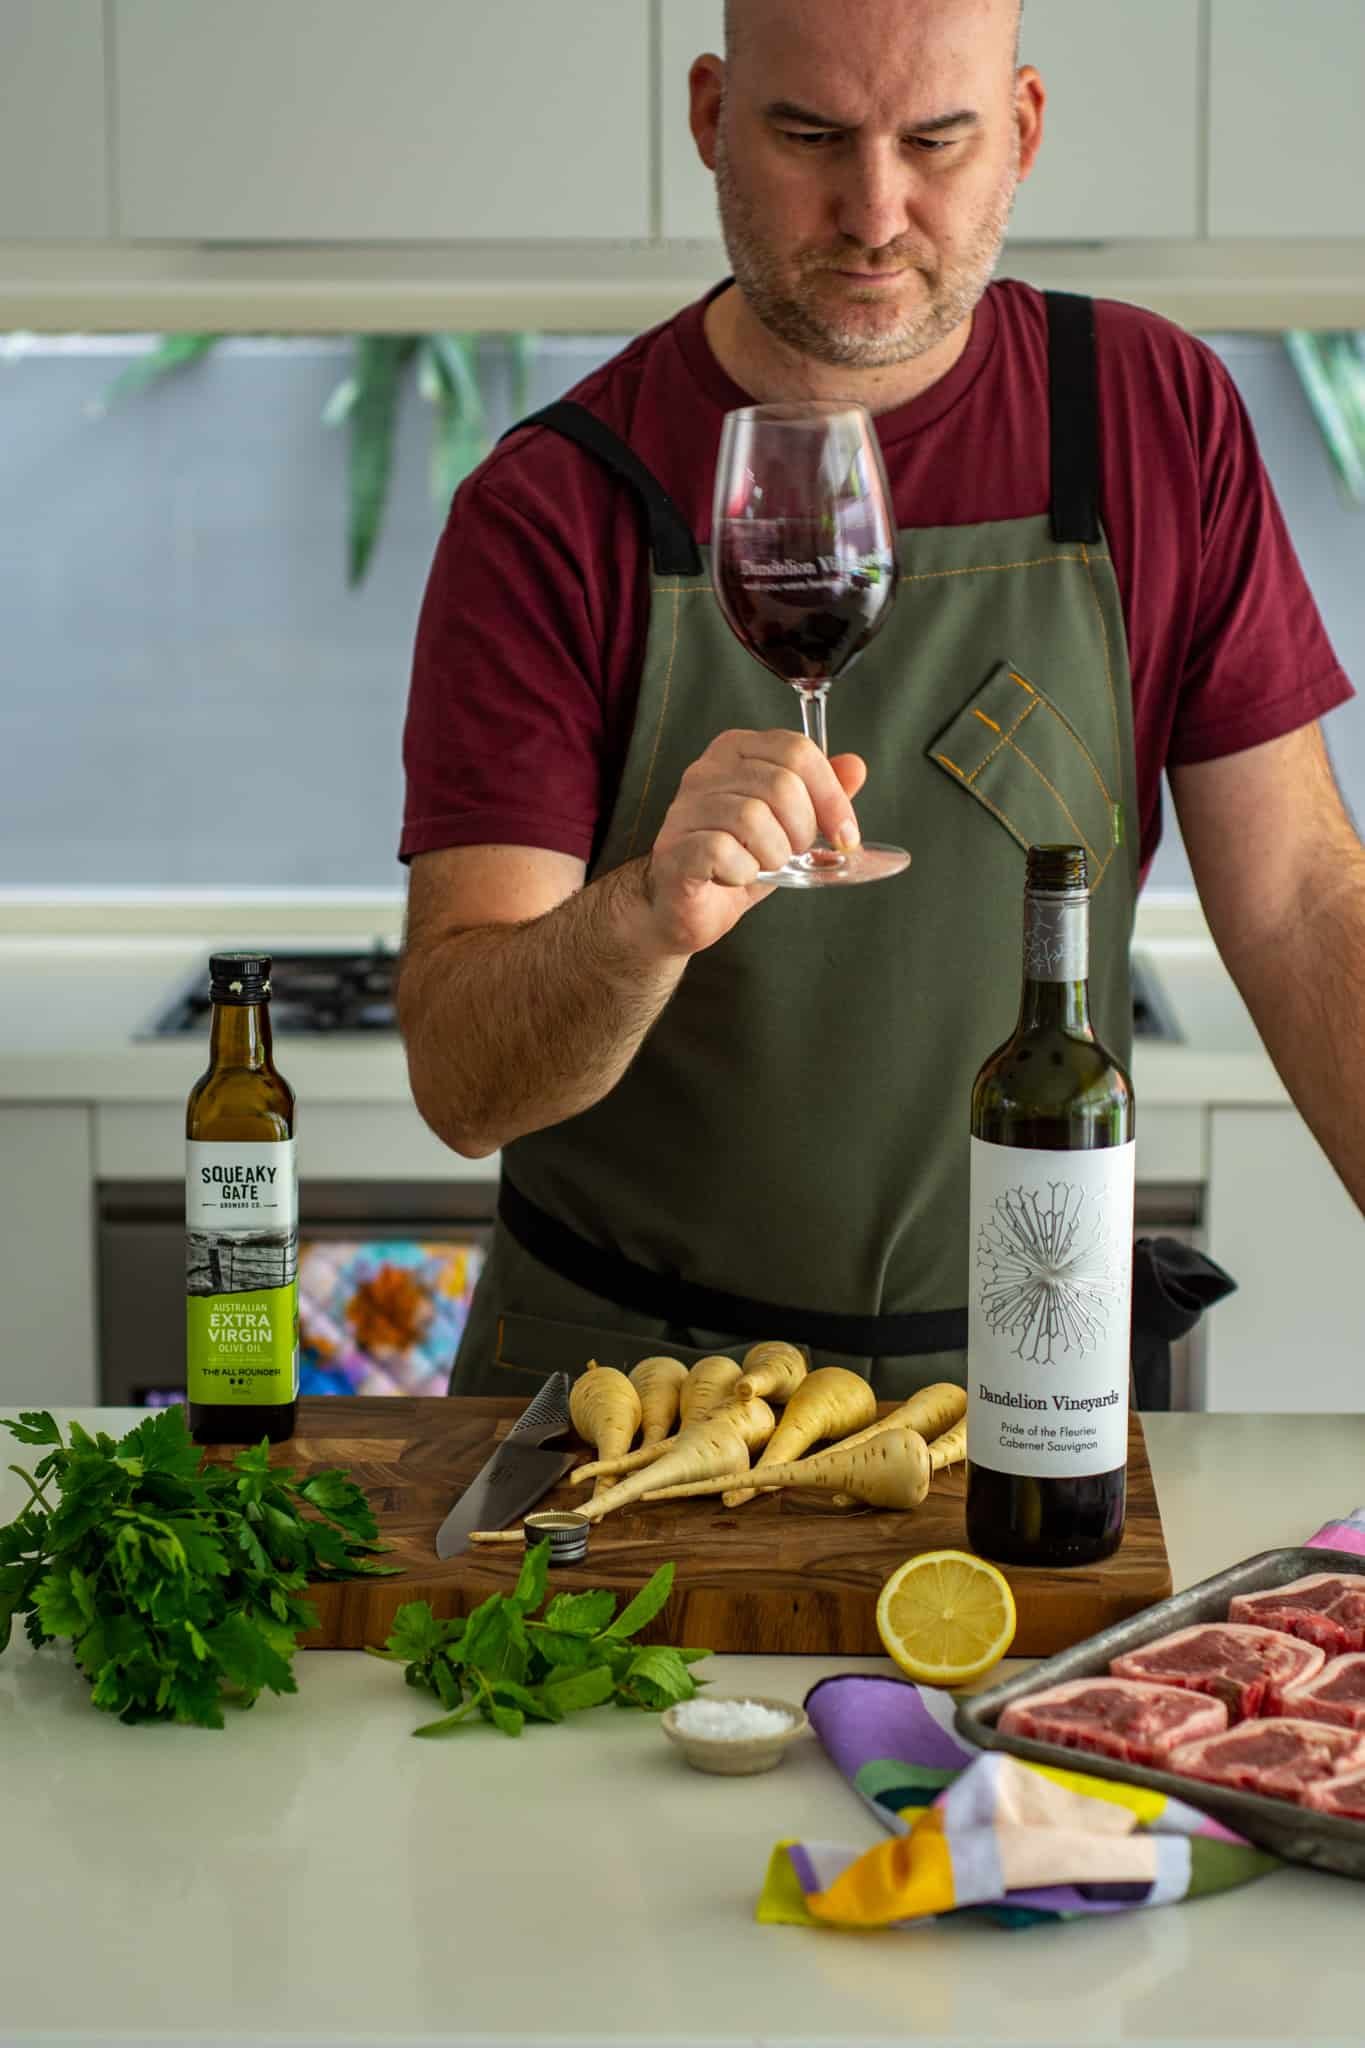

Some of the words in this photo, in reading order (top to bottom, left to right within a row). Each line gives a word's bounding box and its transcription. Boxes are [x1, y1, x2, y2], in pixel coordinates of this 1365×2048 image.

[201, 1165, 276, 1184] SQUEAKY
[222, 1184, 258, 1200] GATE
[213, 1303, 268, 1312] AUSTRALIAN
[210, 1313, 271, 1327] EXTRA
[208, 1328, 273, 1342] VIRGIN
[218, 1344, 244, 1353] OLIVE
[247, 1344, 262, 1353] OIL
[203, 1368, 219, 1377] THE
[221, 1368, 237, 1377] ALL
[238, 1368, 281, 1377] ROUNDER
[979, 1384, 1048, 1410] Dandelion
[1052, 1390, 1119, 1413] Vineyards
[1001, 1422, 1025, 1435] Pride
[1027, 1426, 1038, 1436] of
[1041, 1426, 1057, 1437] the
[1060, 1426, 1097, 1438] Fleurieu
[999, 1436, 1044, 1451] Cabernet
[1047, 1441, 1098, 1453] Sauvignon
